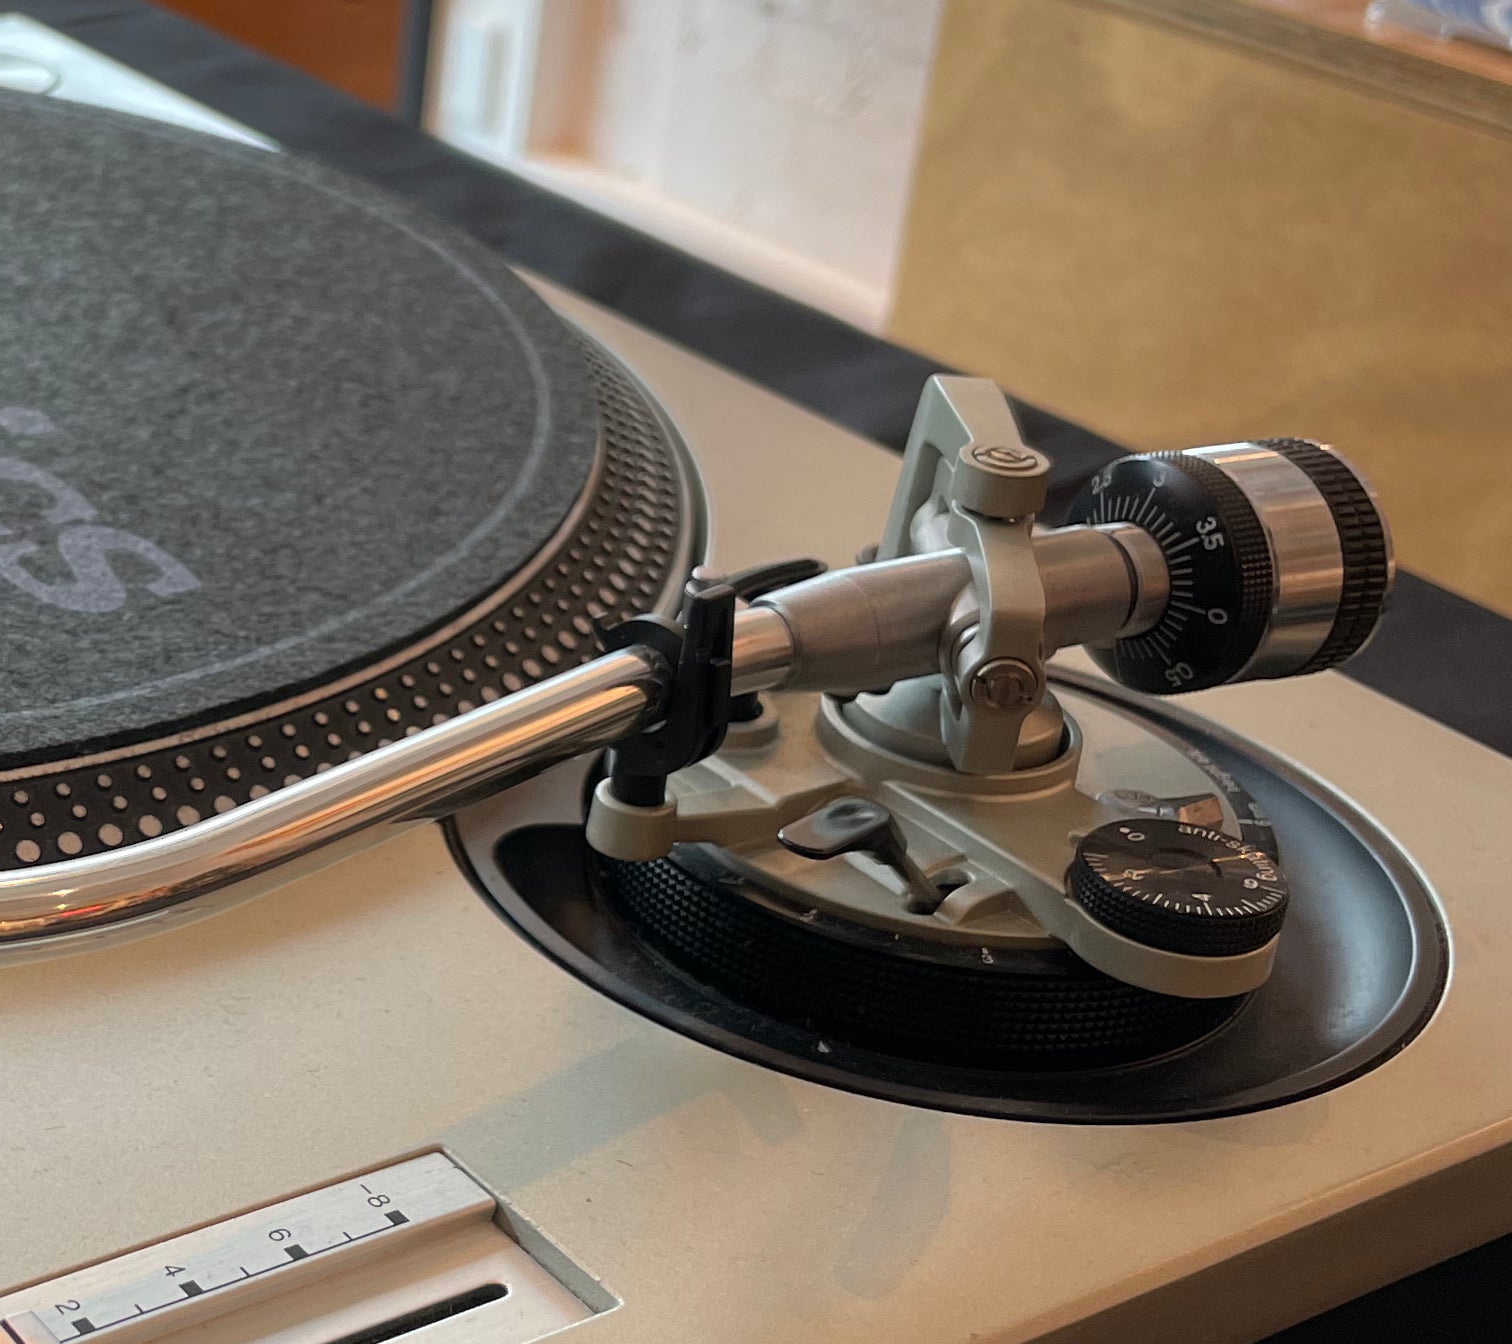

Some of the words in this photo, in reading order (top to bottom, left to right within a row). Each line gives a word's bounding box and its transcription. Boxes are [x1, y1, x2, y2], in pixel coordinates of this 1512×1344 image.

[1207, 608, 1229, 625] 0
[268, 1227, 292, 1242] 6
[164, 1264, 187, 1278] 4
[54, 1298, 82, 1316] 2
